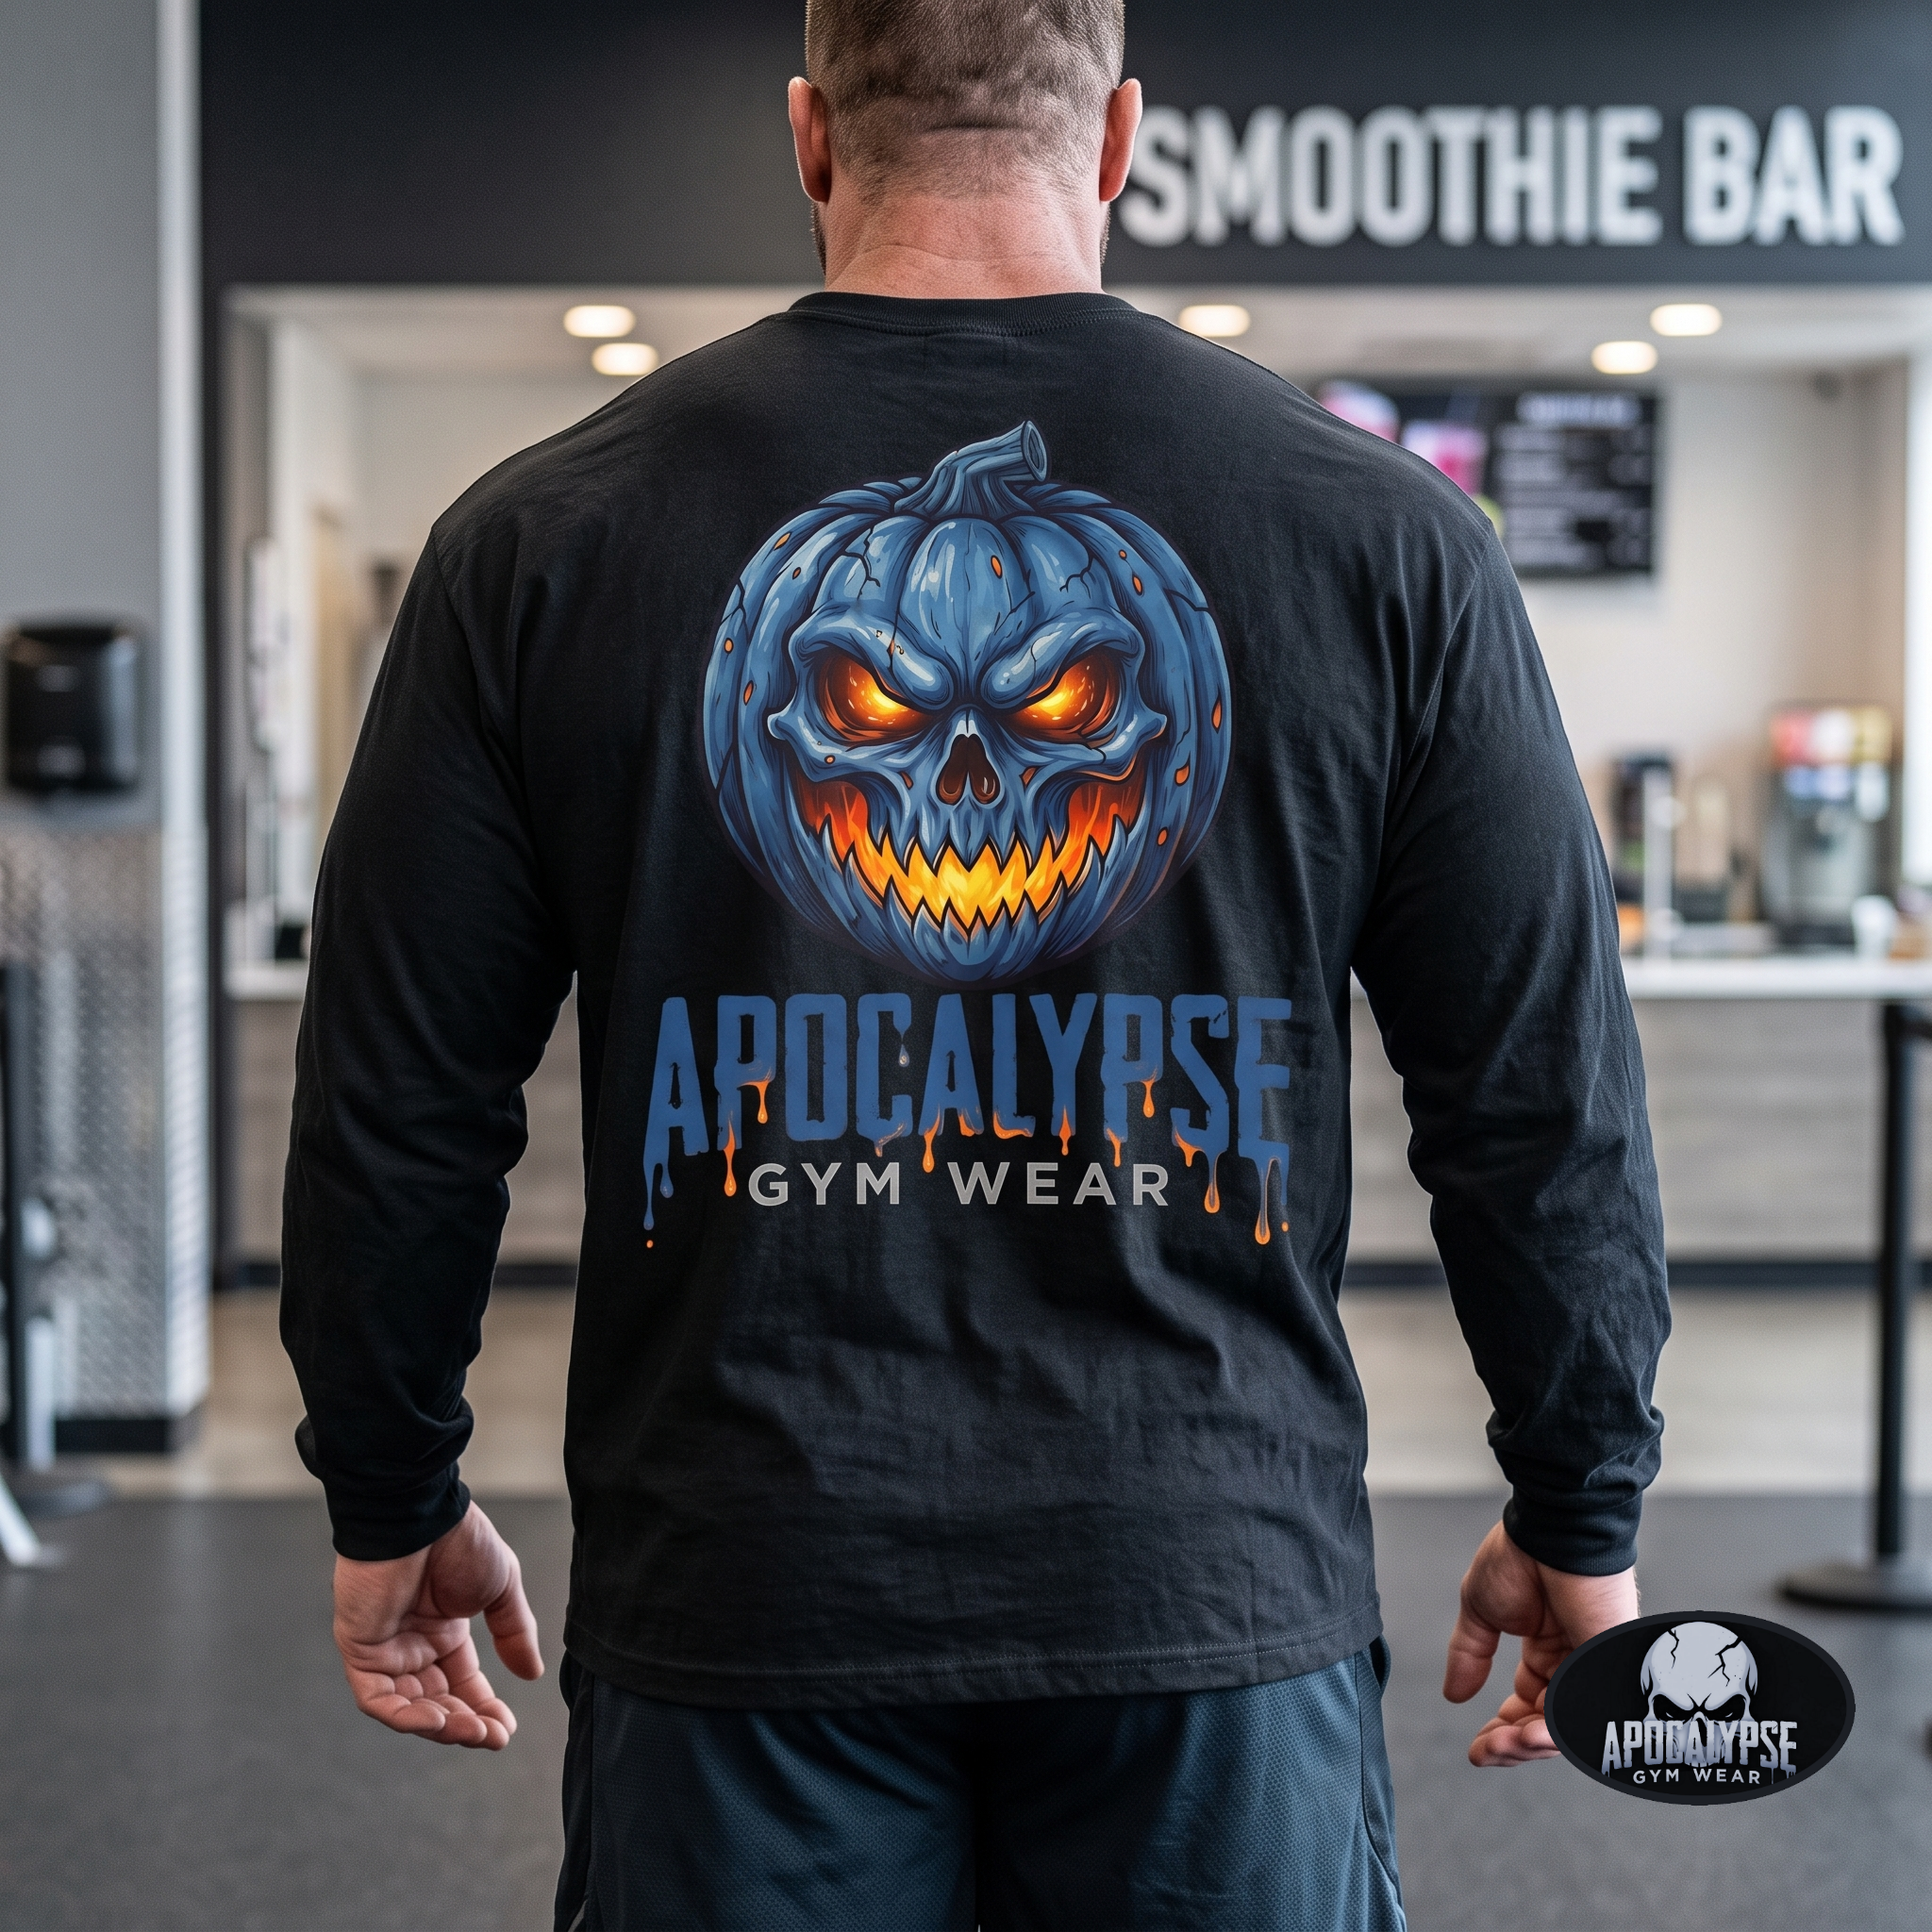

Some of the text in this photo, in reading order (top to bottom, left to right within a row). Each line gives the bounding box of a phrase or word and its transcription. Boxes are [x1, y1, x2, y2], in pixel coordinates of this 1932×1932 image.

[1120, 105, 1905, 246] SMOOTHIE BAR
[642, 992, 1292, 1231] APOCALYPSE
[748, 1161, 1169, 1207] GYM WEAR
